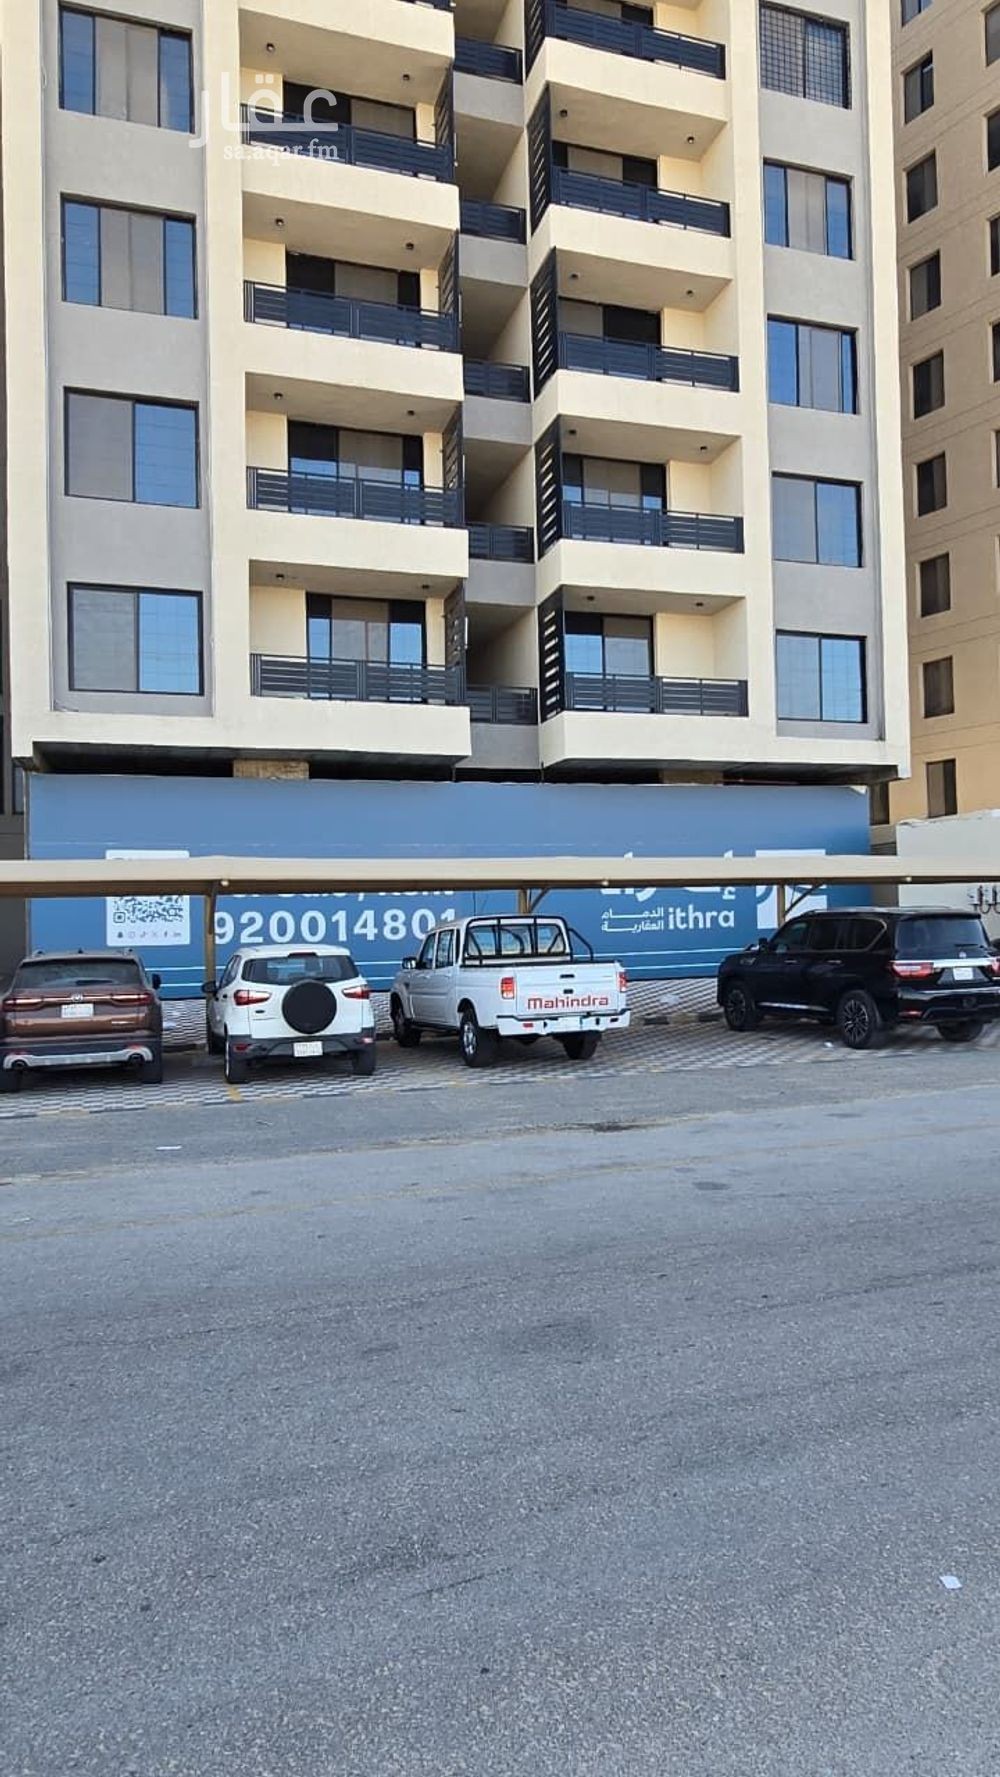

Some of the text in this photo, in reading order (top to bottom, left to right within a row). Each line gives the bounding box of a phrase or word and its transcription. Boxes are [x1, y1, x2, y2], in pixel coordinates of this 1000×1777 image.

[668, 904, 735, 930] ithra
[601, 919, 664, 934] العقارية
[527, 995, 609, 1010] Mahindra
